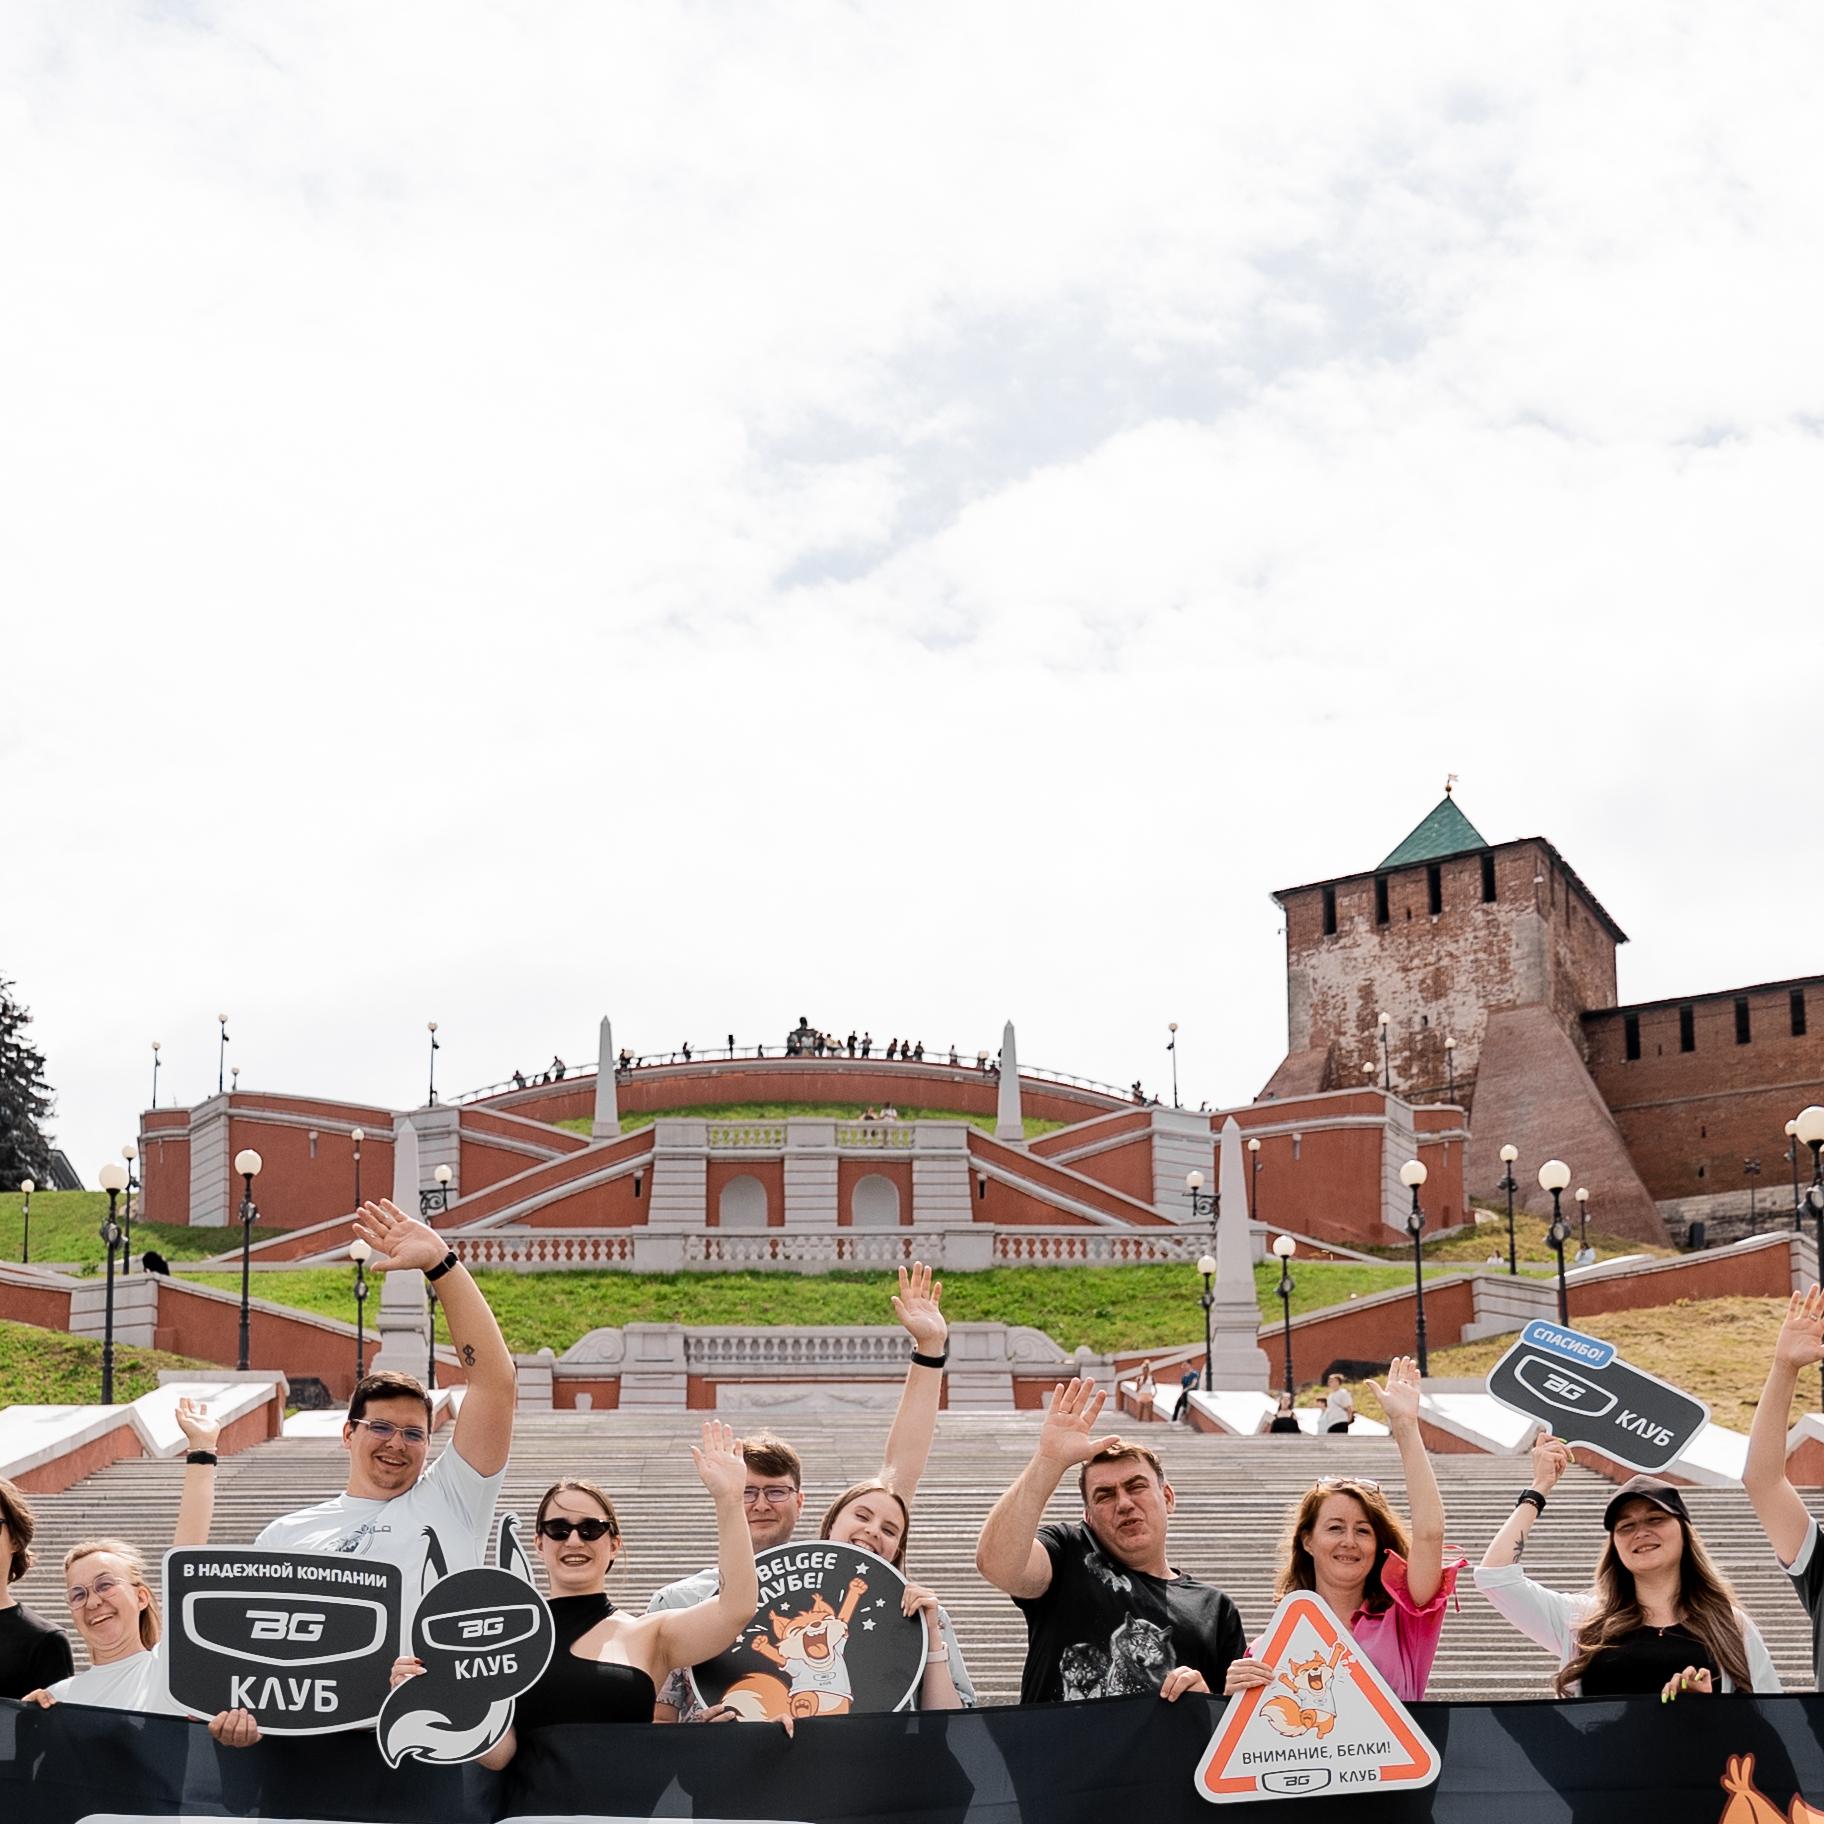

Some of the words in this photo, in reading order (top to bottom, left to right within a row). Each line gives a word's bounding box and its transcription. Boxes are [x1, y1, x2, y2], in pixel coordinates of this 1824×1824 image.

[1533, 1327, 1606, 1362] СПАСИБО!
[1542, 1373, 1587, 1401] BG
[1614, 1409, 1676, 1447] КЛУБ
[183, 1563, 195, 1578] В
[198, 1561, 293, 1579] НАДЕЖНОЙ
[297, 1566, 388, 1589] КОМПАНИИ
[756, 1551, 838, 1583] BELGEE
[755, 1571, 825, 1614] ЛУБЕ!
[245, 1609, 326, 1642] BG
[457, 1616, 505, 1639] BG
[454, 1653, 519, 1680] КЛУБ
[230, 1675, 340, 1713] КЛУБ
[1242, 1745, 1333, 1765] ВНИМАНИЕ,
[1337, 1741, 1391, 1758] БЕЛКИ!
[1283, 1774, 1311, 1787] BG
[1339, 1769, 1378, 1783] КЛУБ
